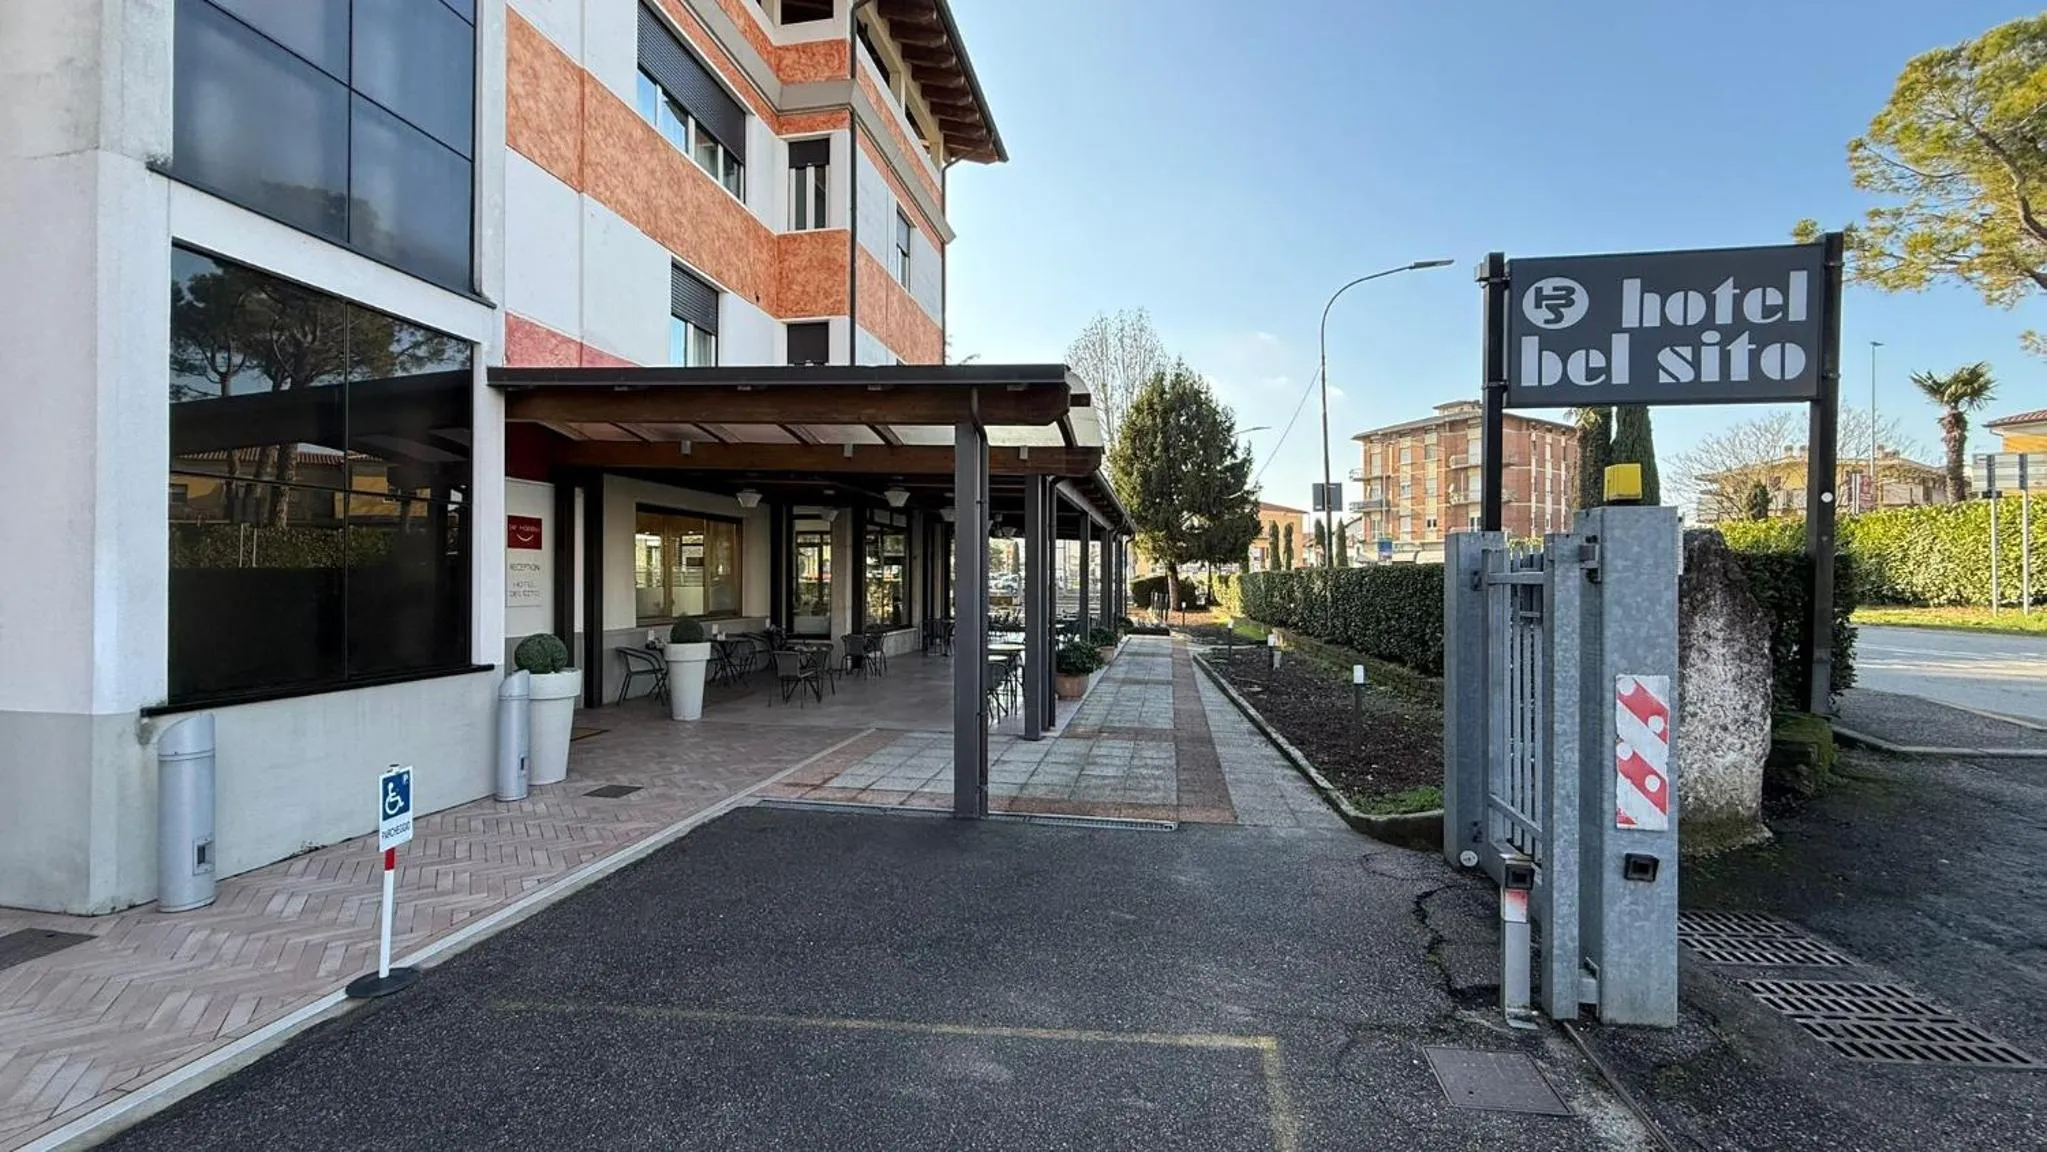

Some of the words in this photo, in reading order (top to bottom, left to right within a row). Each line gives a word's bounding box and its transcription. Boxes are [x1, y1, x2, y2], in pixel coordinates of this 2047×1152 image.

[1622, 270, 1808, 328] hotel
[1520, 332, 1630, 386] bel
[1656, 330, 1806, 383] sito
